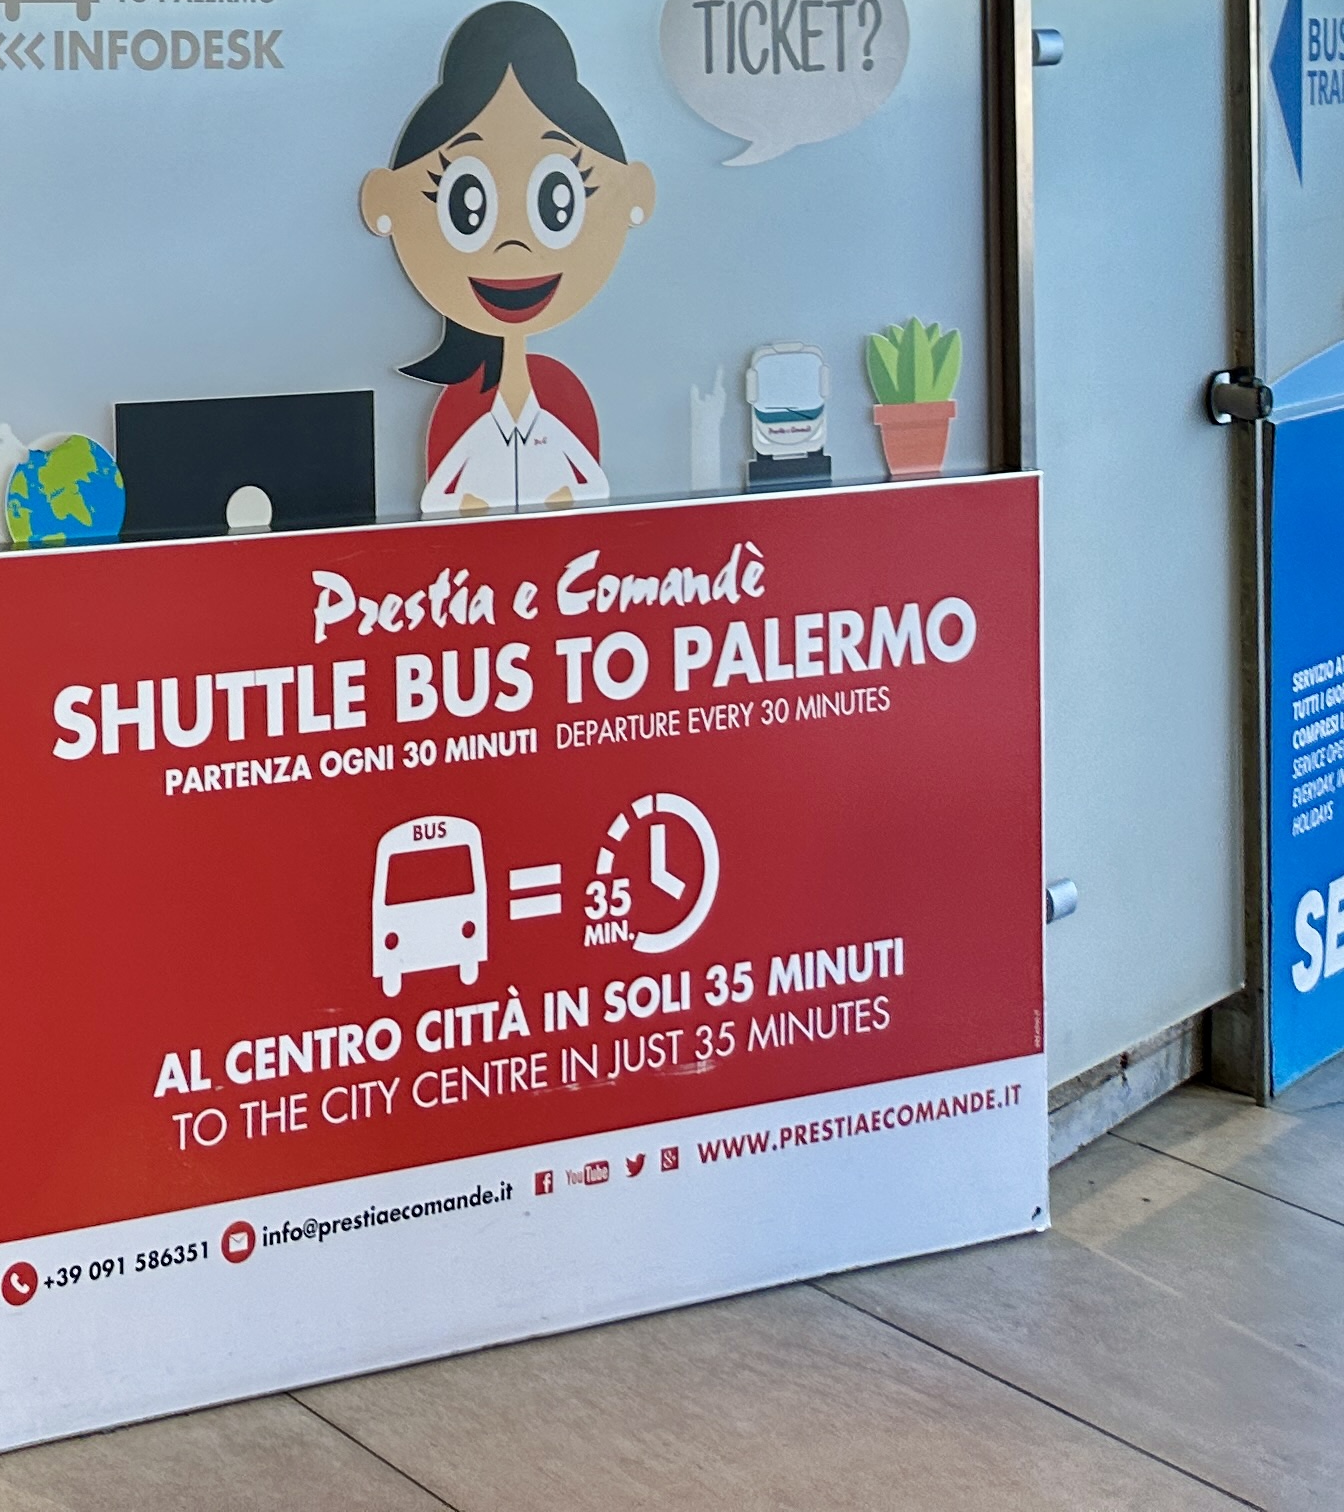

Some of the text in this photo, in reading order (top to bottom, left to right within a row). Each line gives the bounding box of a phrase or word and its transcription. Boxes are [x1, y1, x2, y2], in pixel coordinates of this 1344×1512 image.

[53, 28, 285, 72] INFODESK
[1307, 69, 1344, 106] TRA
[311, 541, 766, 644] Prestia e Comandè
[52, 595, 978, 761] SHUTTLE BUS TO PALERMO
[1292, 659, 1335, 693] SERVIZIO
[1292, 692, 1320, 721] TUTTI
[165, 684, 891, 796] PARTENZA OGNI 30 MINUTI DEPARTURE EVERY 30 MINUTES
[1292, 711, 1339, 751] COMPRESI
[1292, 746, 1327, 780] SERVICE
[411, 821, 449, 844] BUS
[1292, 800, 1335, 838] HOLIDAYS
[583, 878, 633, 922] 35
[583, 919, 636, 949] MIN.
[153, 936, 905, 1098] AL CENTRO CITTÀ IN SOLI 35 MINUTI
[172, 995, 892, 1151] TO THE CITY CENTRE IN JUST 35 MINUTES
[43, 1265, 83, 1291] +39
[88, 1255, 126, 1283] 091
[134, 1239, 210, 1273] 586351
[262, 1181, 514, 1249] info@prestiaecomande.it
[697, 1084, 1022, 1164] WWW.PRESTIAECOMANDE.IT
